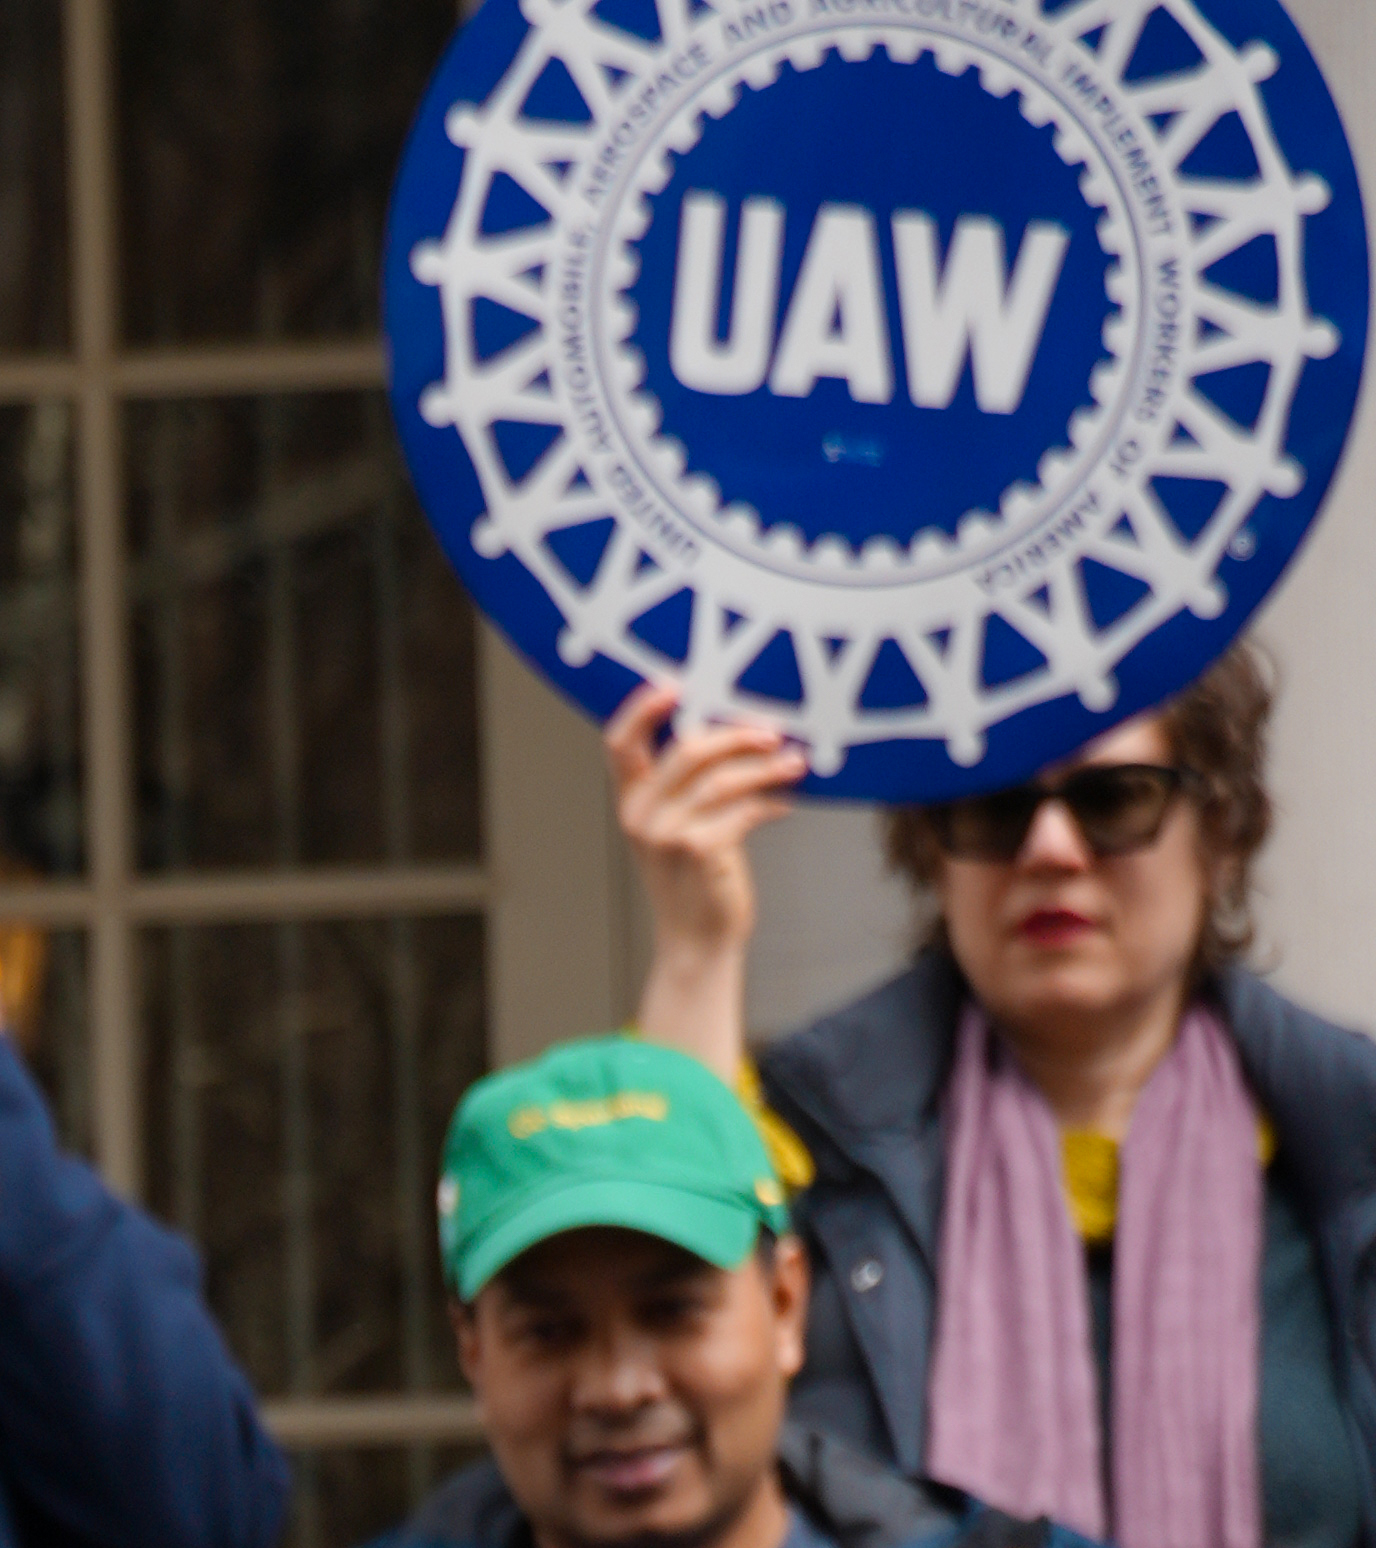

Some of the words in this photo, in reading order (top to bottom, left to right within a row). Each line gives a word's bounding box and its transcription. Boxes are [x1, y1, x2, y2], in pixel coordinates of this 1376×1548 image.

[1063, 63, 1179, 238] IMPLEMENT
[669, 189, 1072, 414] UAW
[1136, 258, 1182, 425] WORKERS
[978, 487, 1103, 593] AMERICA
[1110, 438, 1141, 478] OF
